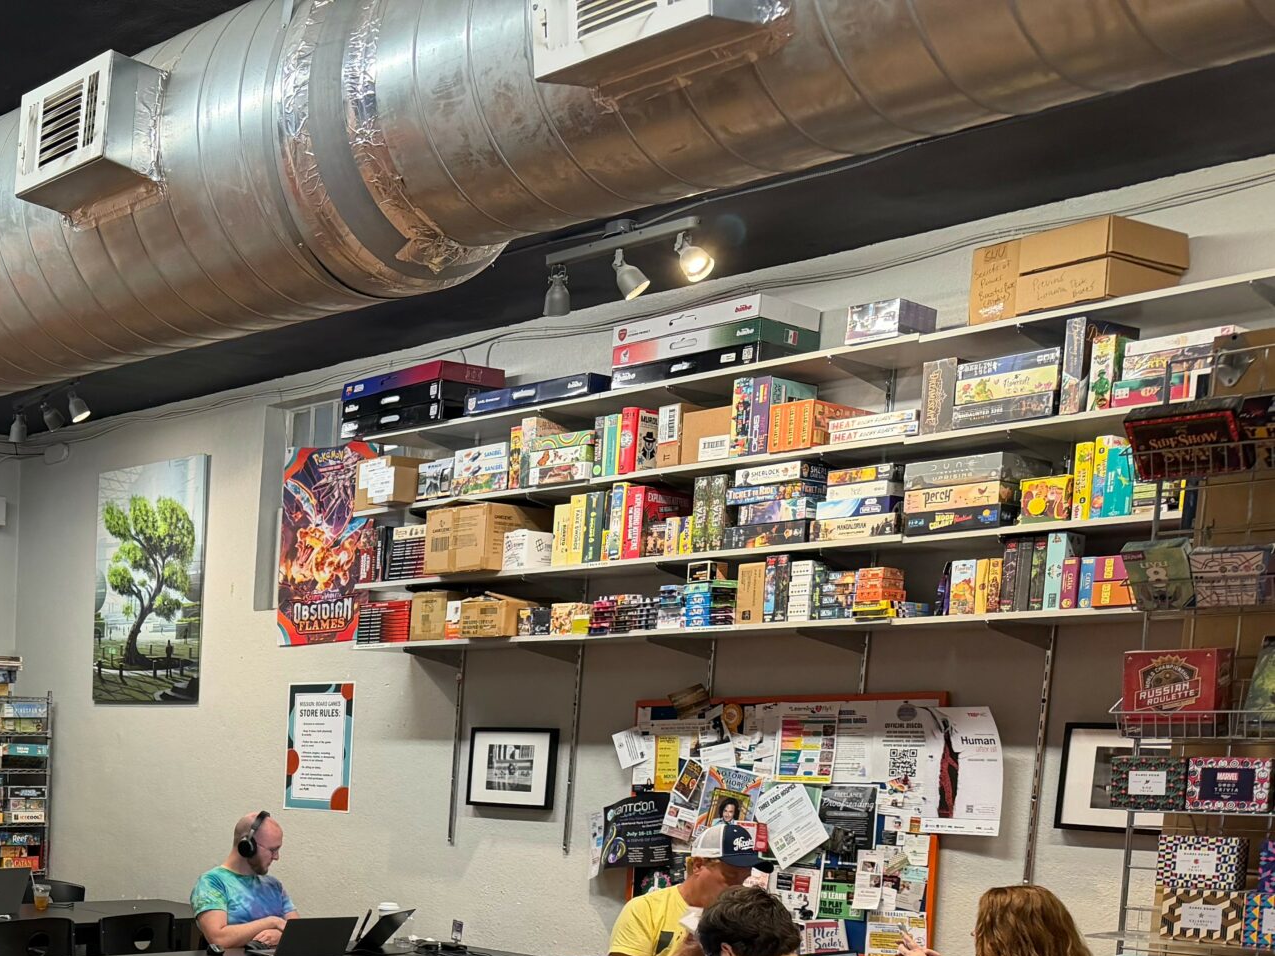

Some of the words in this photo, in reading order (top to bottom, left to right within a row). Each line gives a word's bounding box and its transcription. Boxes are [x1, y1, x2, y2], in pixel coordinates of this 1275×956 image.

[831, 419, 855, 431] HEAT
[833, 431, 858, 442] HEAT
[751, 469, 780, 477] SHERLOCK
[932, 472, 973, 481] UPRISING
[729, 489, 752, 499] TICKET
[759, 485, 776, 496] RIDE
[293, 597, 353, 622] OBSIDIAN
[298, 618, 345, 631] FLAMES
[1139, 682, 1190, 700] RUSSIAN
[1147, 690, 1195, 705] ROULETTE
[299, 709, 319, 717] STORE
[319, 709, 341, 717] RULES:
[961, 736, 996, 746] Human
[1217, 772, 1239, 781] MARVEL
[758, 801, 771, 812] THREE
[821, 796, 875, 812] Proofreading
[12, 834, 27, 843] Reef
[13, 858, 32, 867] CATAN
[828, 892, 847, 900] LEARN
[828, 901, 843, 909] PLAY
[813, 926, 839, 938] Meet
[814, 937, 843, 950] Sailor
